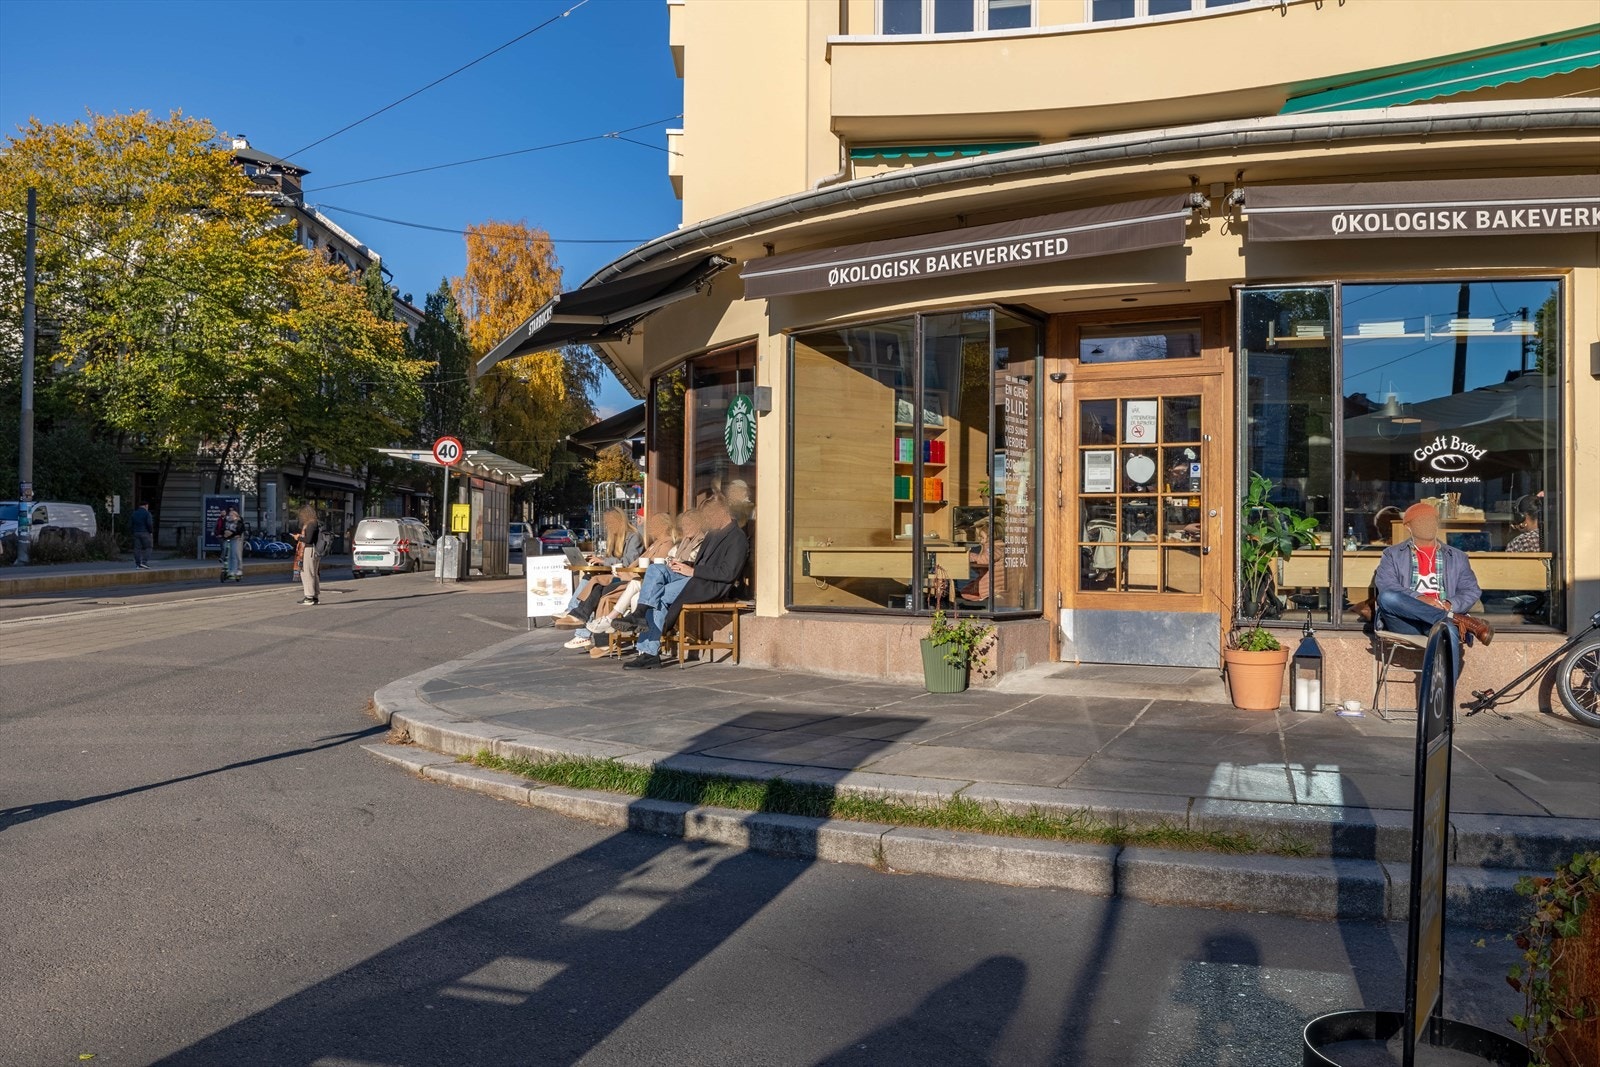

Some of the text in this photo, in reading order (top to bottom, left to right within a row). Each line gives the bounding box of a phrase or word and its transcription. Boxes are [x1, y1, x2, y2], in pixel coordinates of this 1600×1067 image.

[1331, 211, 1468, 234] ØKOLOGISK
[828, 237, 1068, 286] ØKOLOGISK BAKEVERKSTED
[1005, 384, 1012, 395] EN
[1005, 398, 1028, 417] BLIDE
[1005, 424, 1014, 434] MED
[438, 444, 457, 458] 40
[1414, 435, 1487, 461] Godt Brød
[1005, 554, 1028, 568] STIGE PÅ.
